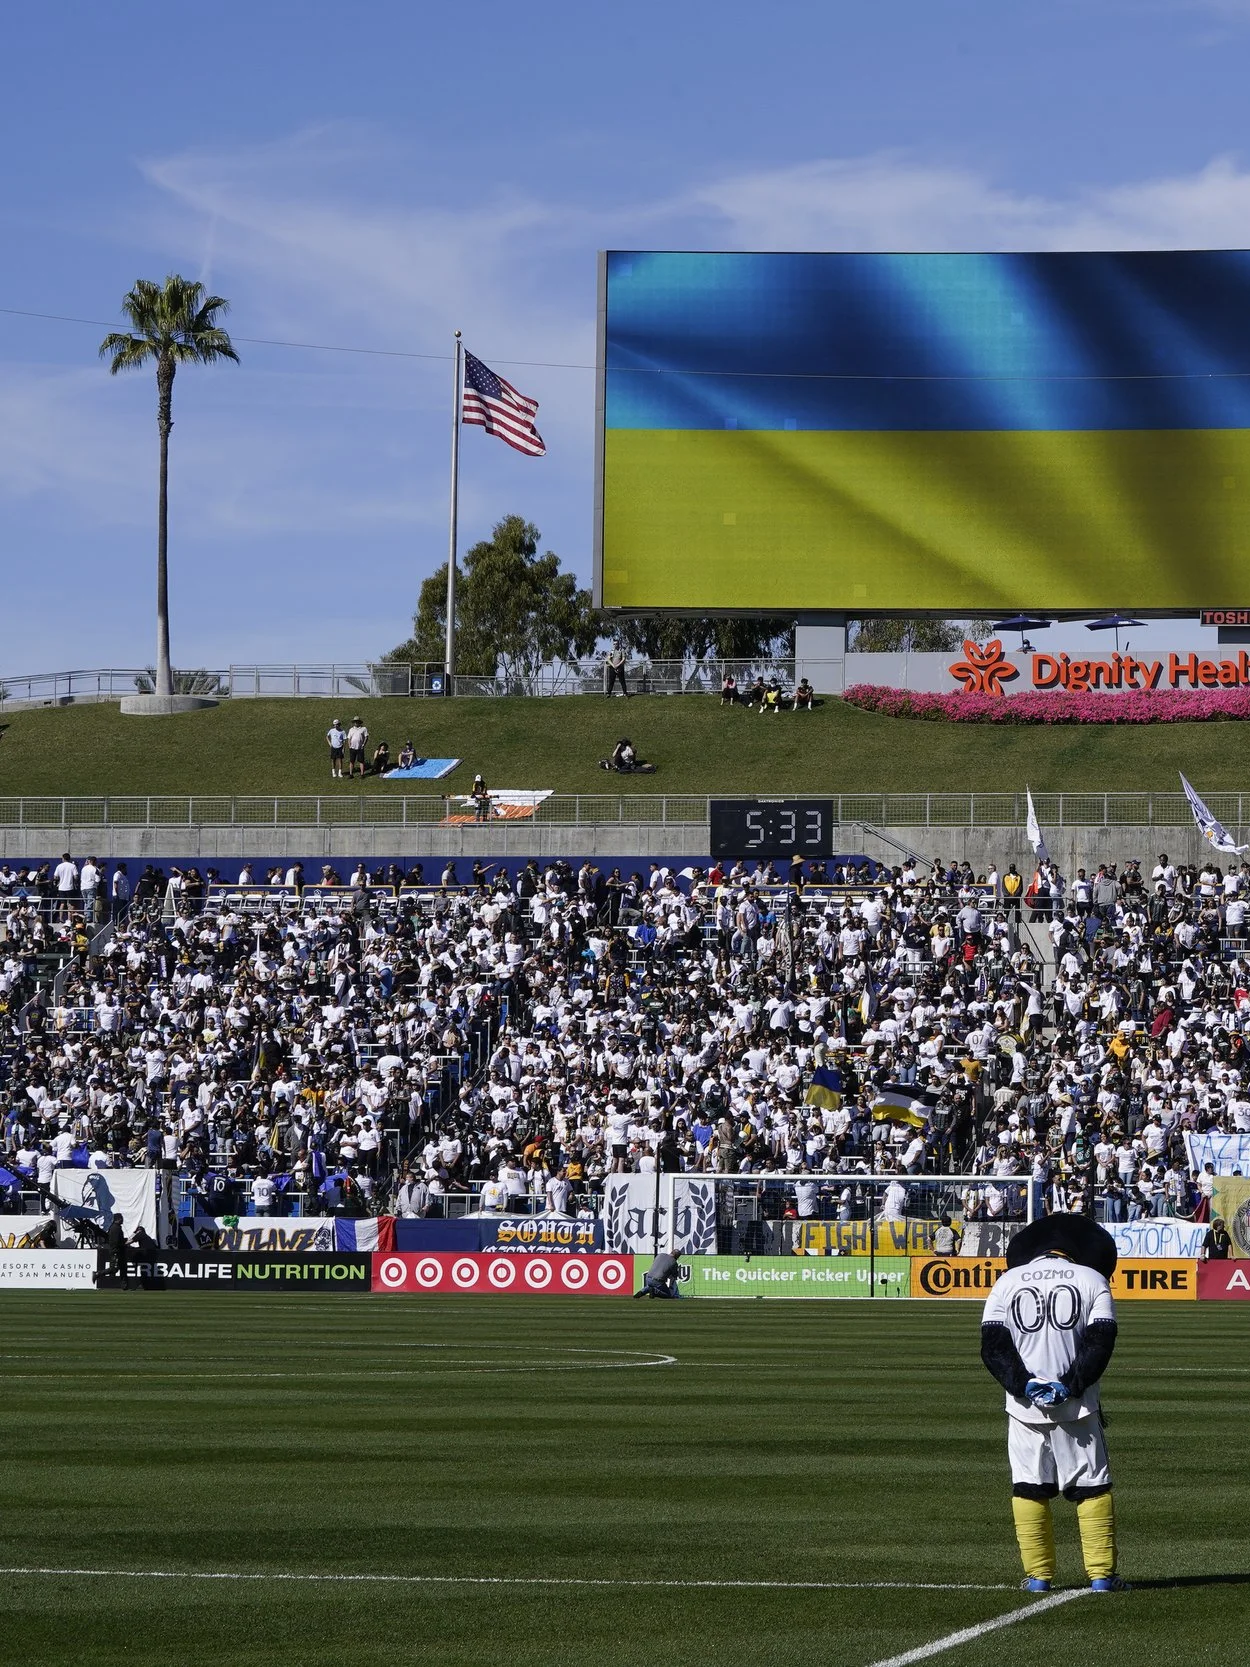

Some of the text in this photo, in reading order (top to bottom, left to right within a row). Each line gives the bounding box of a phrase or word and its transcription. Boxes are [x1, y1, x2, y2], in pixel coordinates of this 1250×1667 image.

[1031, 652, 1161, 691] Dignity
[746, 811, 821, 844] 5:33
[972, 1034, 984, 1044] 07
[1188, 1135, 1232, 1160] PAZ
[213, 1178, 225, 1192] 10
[257, 1187, 269, 1197] 10
[218, 1227, 317, 1251] OUTLAWZ
[496, 1219, 596, 1245] SOUTH
[804, 1221, 883, 1250] FIGHT
[1177, 1227, 1209, 1257] WA
[237, 1264, 365, 1280] NUTRITION
[702, 1268, 731, 1281] The
[735, 1268, 798, 1283] Quicker
[802, 1268, 851, 1282] Picker
[856, 1269, 904, 1286] Upper
[1021, 1268, 1075, 1283] COZMO
[1121, 1270, 1188, 1290] TIRE
[1011, 1283, 1081, 1334] 00
